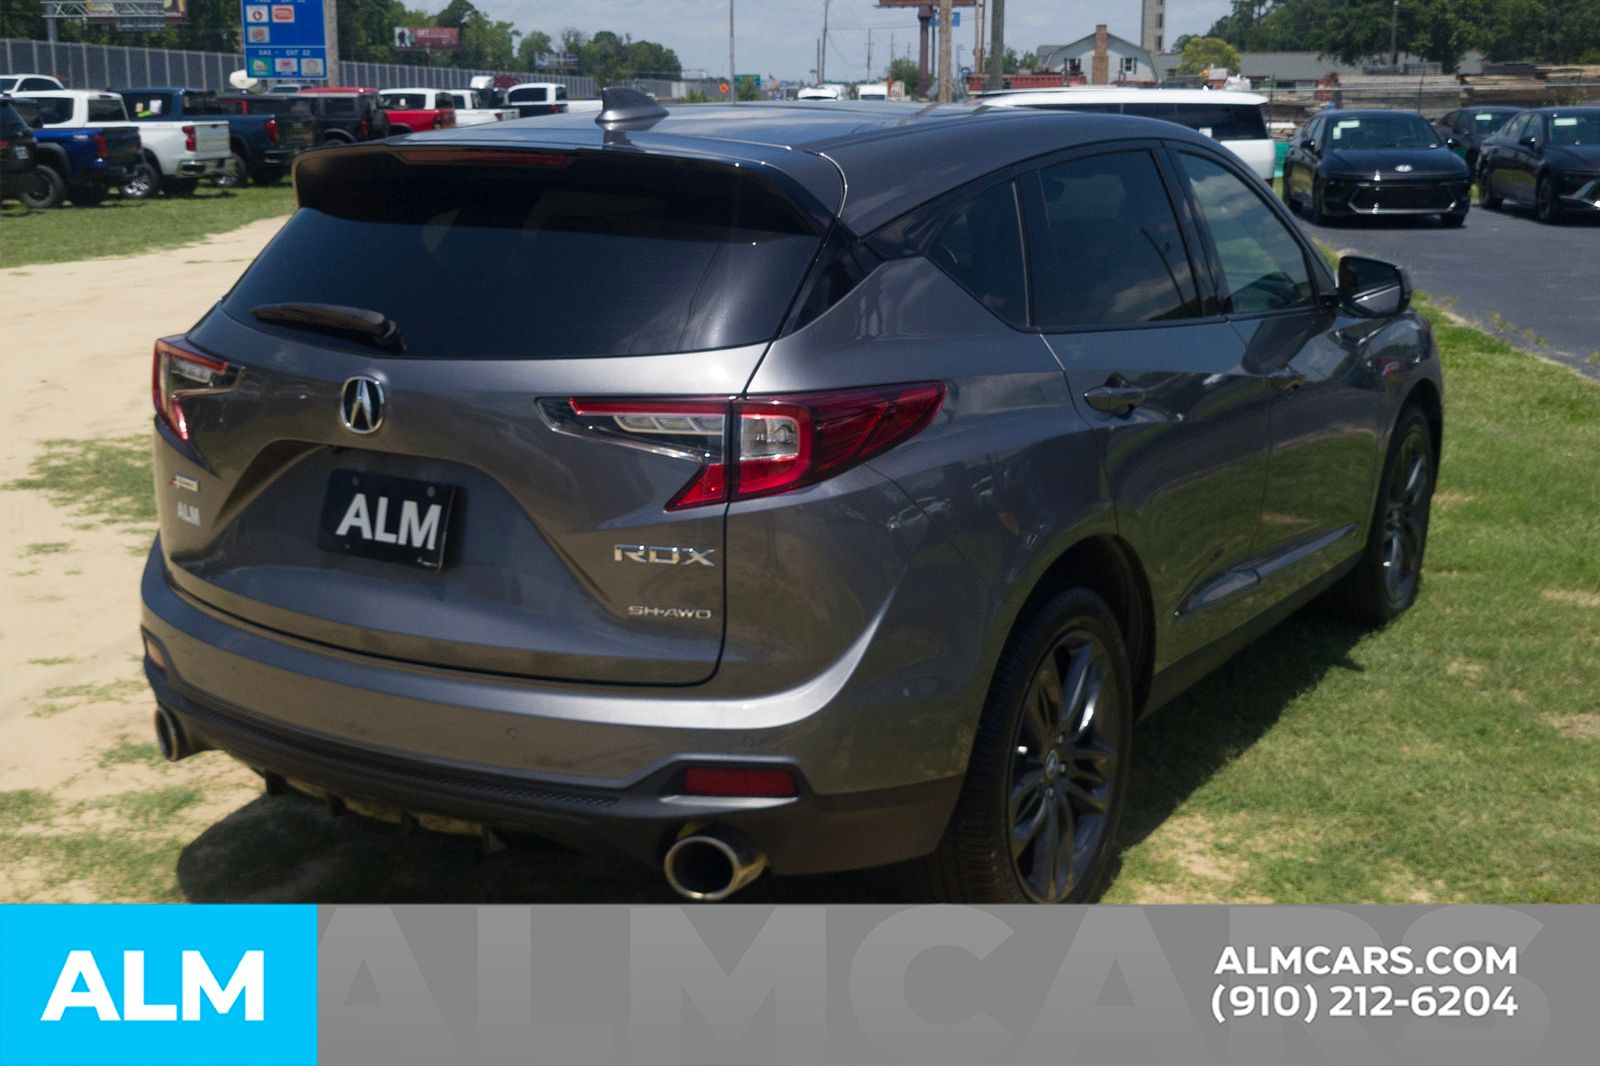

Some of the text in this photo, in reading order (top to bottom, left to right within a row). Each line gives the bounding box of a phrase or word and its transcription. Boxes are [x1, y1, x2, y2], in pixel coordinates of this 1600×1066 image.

[176, 501, 201, 527] ALM
[335, 493, 442, 551] ALM
[613, 544, 716, 567] RDX
[628, 605, 712, 620] SH-AWD
